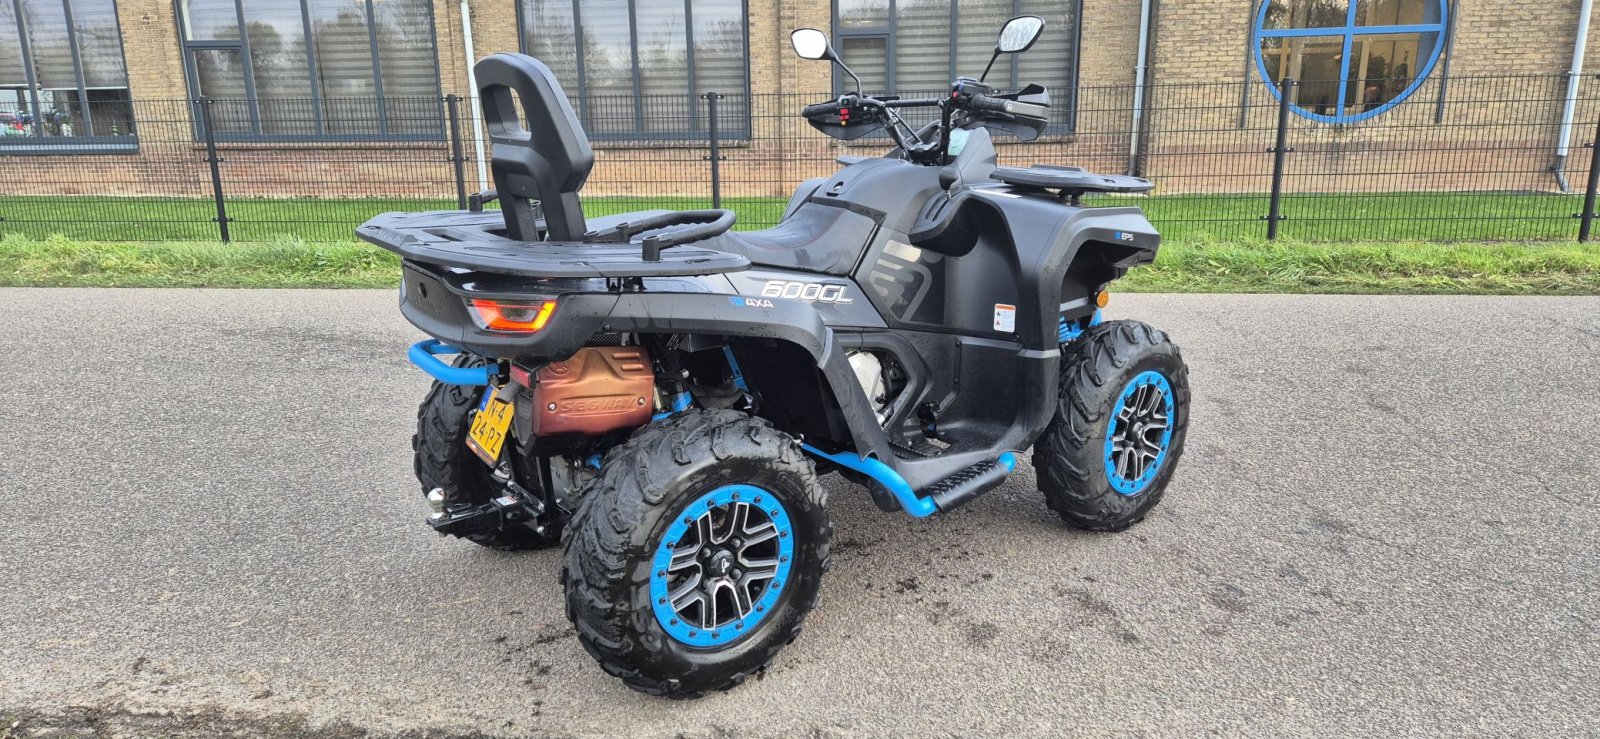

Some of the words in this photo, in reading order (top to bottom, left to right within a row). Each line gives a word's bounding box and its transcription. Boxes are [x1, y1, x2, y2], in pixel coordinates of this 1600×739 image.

[1121, 232, 1134, 241] EPS
[761, 280, 853, 304] 600GL
[488, 400, 507, 424] N-4
[561, 398, 637, 412] SEGWAY
[472, 415, 502, 454] 24-PZ
